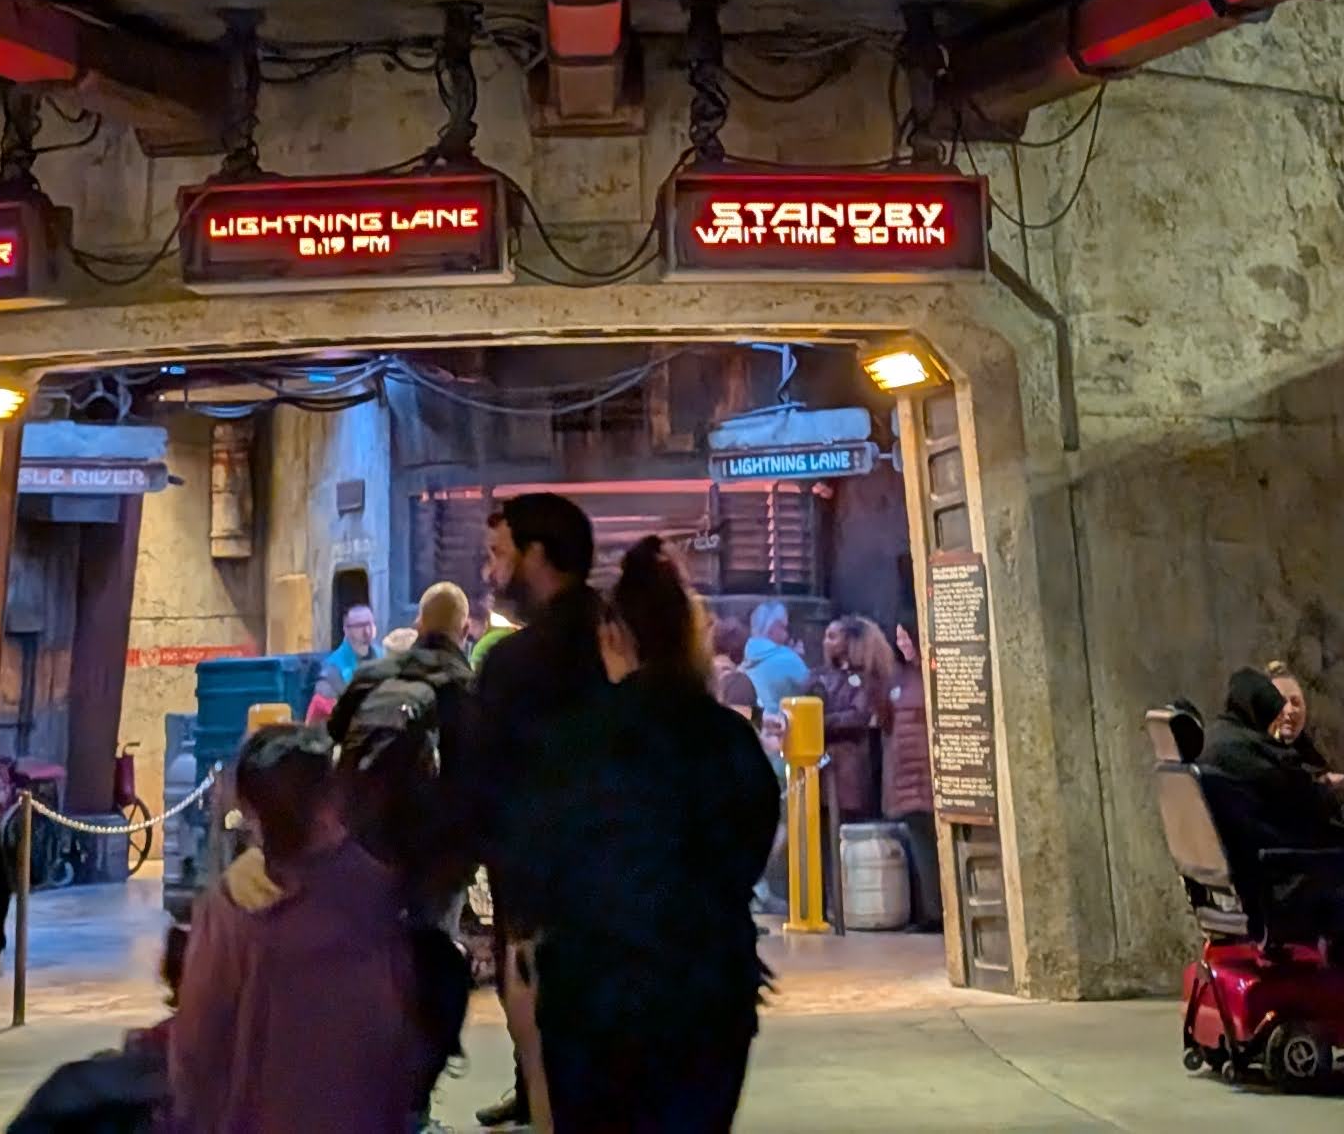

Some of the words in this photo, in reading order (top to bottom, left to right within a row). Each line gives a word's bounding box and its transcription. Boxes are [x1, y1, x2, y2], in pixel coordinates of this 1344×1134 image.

[209, 212, 384, 237] LIGHTNING
[391, 208, 479, 230] LANE
[711, 201, 944, 227] STANDBY
[352, 234, 391, 254] PM
[695, 226, 767, 244] WAIT
[772, 226, 837, 244] TIME
[853, 226, 890, 244] 30
[896, 226, 946, 244] MIN
[729, 453, 807, 477] LIGHTNING
[809, 450, 851, 471] LANE
